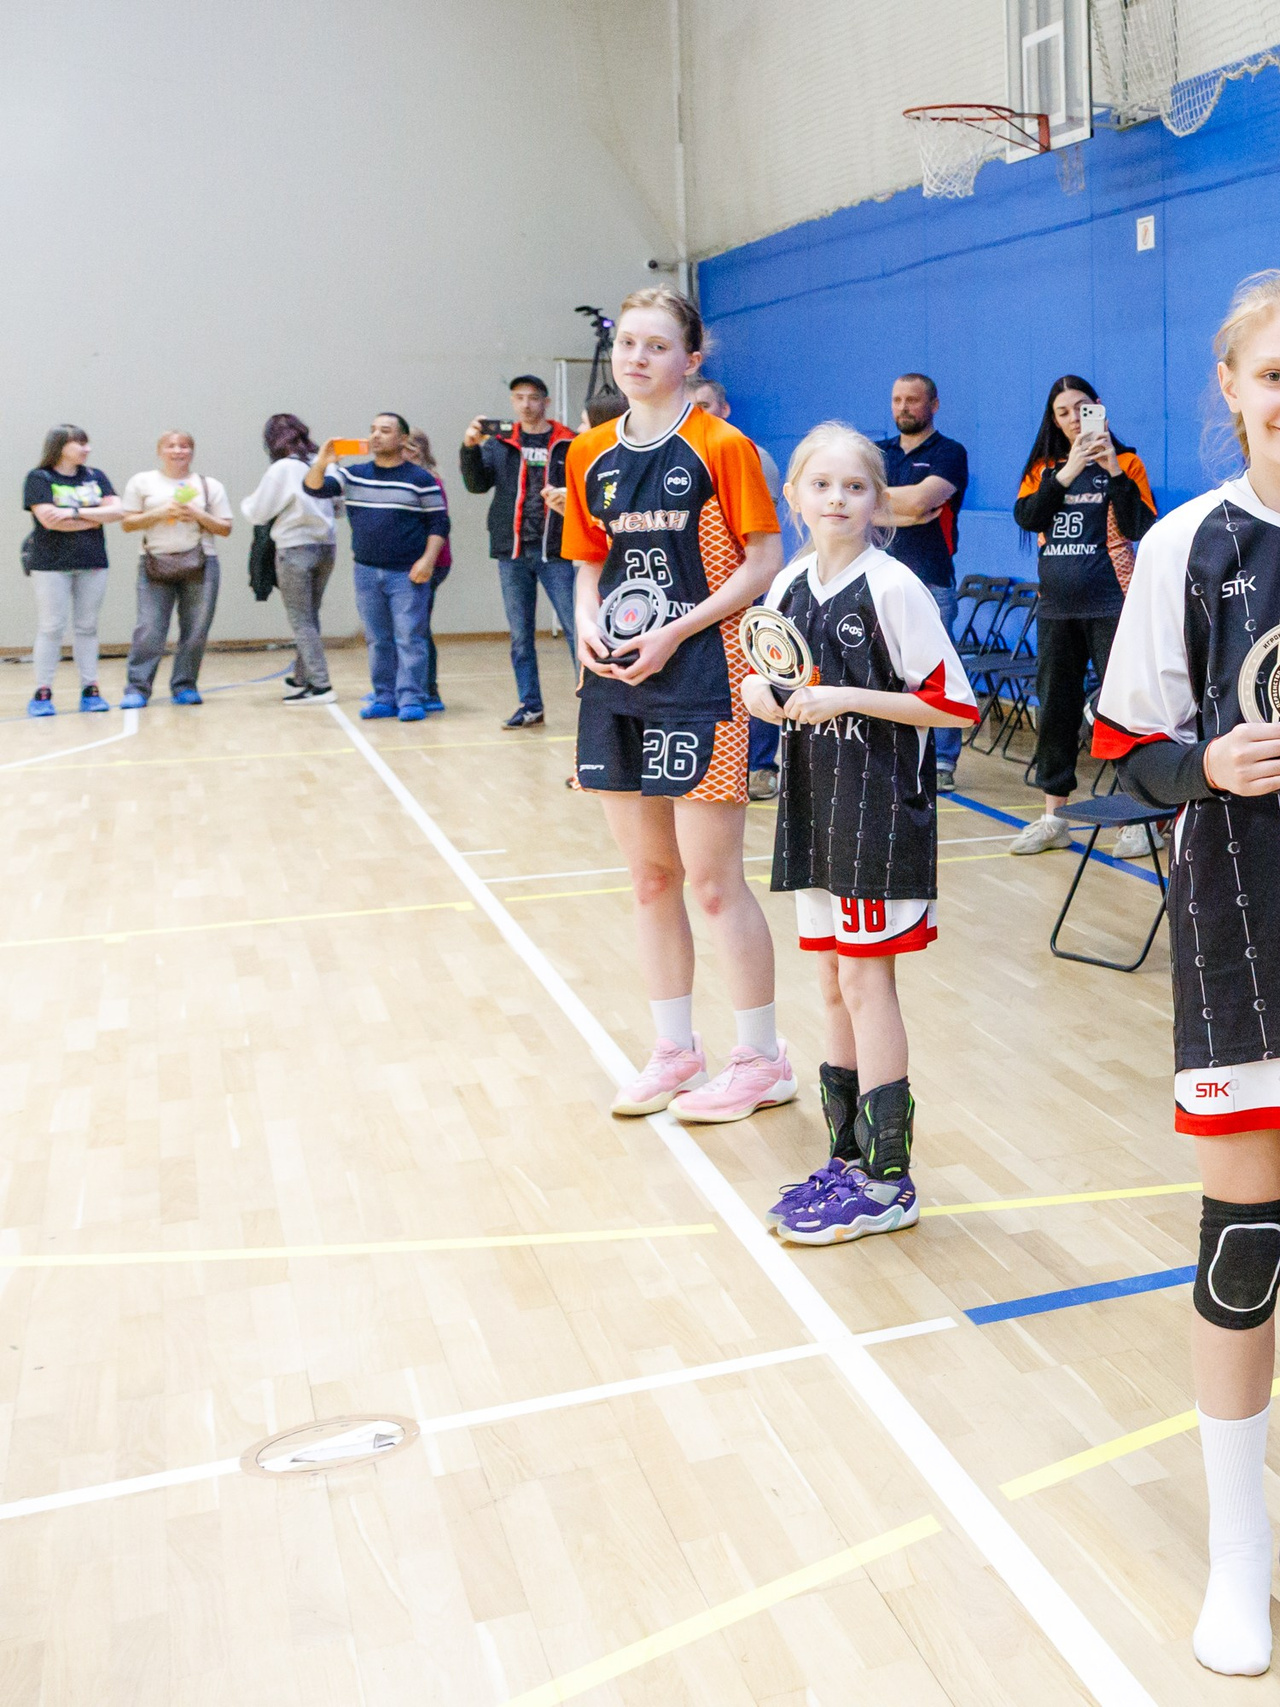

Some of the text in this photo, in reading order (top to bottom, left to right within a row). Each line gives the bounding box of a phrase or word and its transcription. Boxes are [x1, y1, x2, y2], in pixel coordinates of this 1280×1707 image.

[667, 477, 688, 486] РФБ
[1052, 512, 1084, 538] 26
[625, 548, 674, 588] 26
[1221, 575, 1257, 599] STK
[641, 729, 699, 780] 26
[841, 897, 886, 933] 98
[1195, 1082, 1230, 1098] STK
